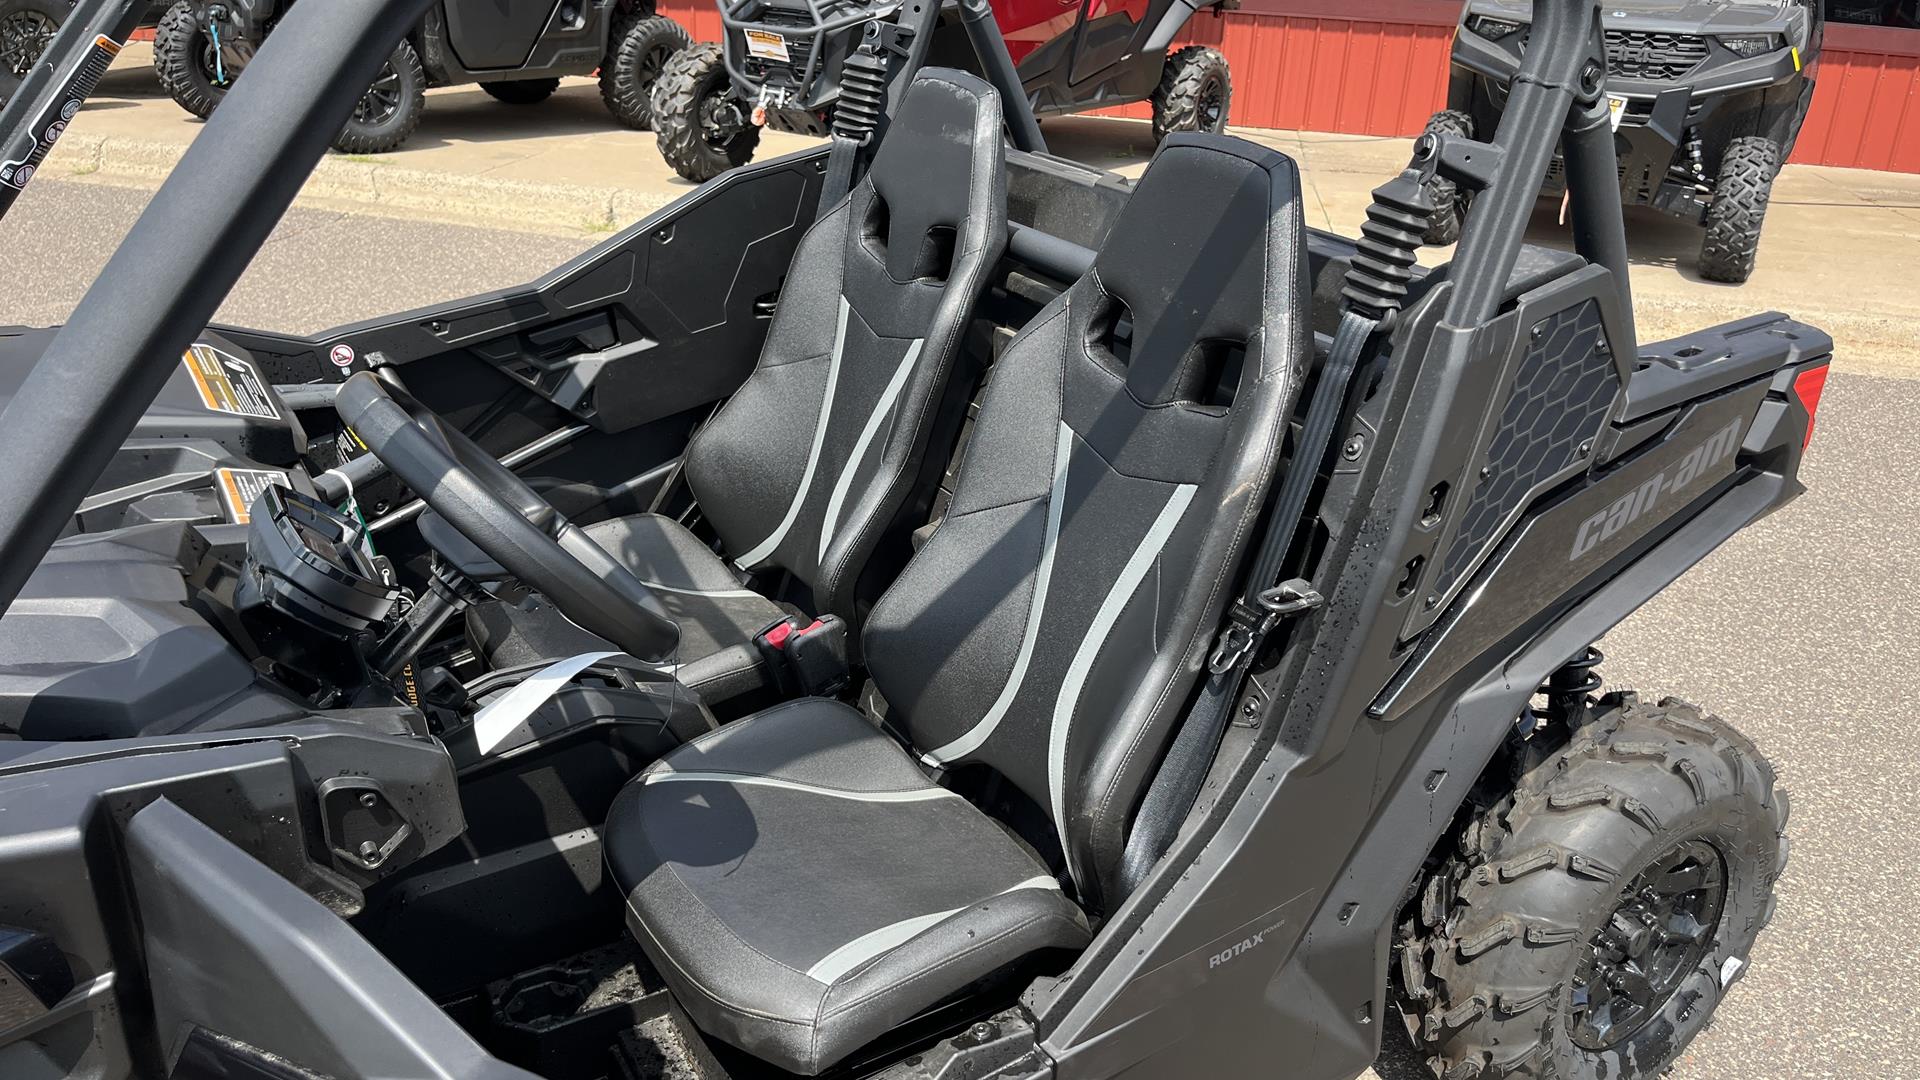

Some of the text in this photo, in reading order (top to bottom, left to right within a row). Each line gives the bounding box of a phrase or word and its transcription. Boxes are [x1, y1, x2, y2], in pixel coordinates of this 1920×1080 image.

[1605, 46, 1667, 63] ARIS
[1569, 415, 1742, 561] can-am
[1208, 931, 1264, 969] ROTAX
